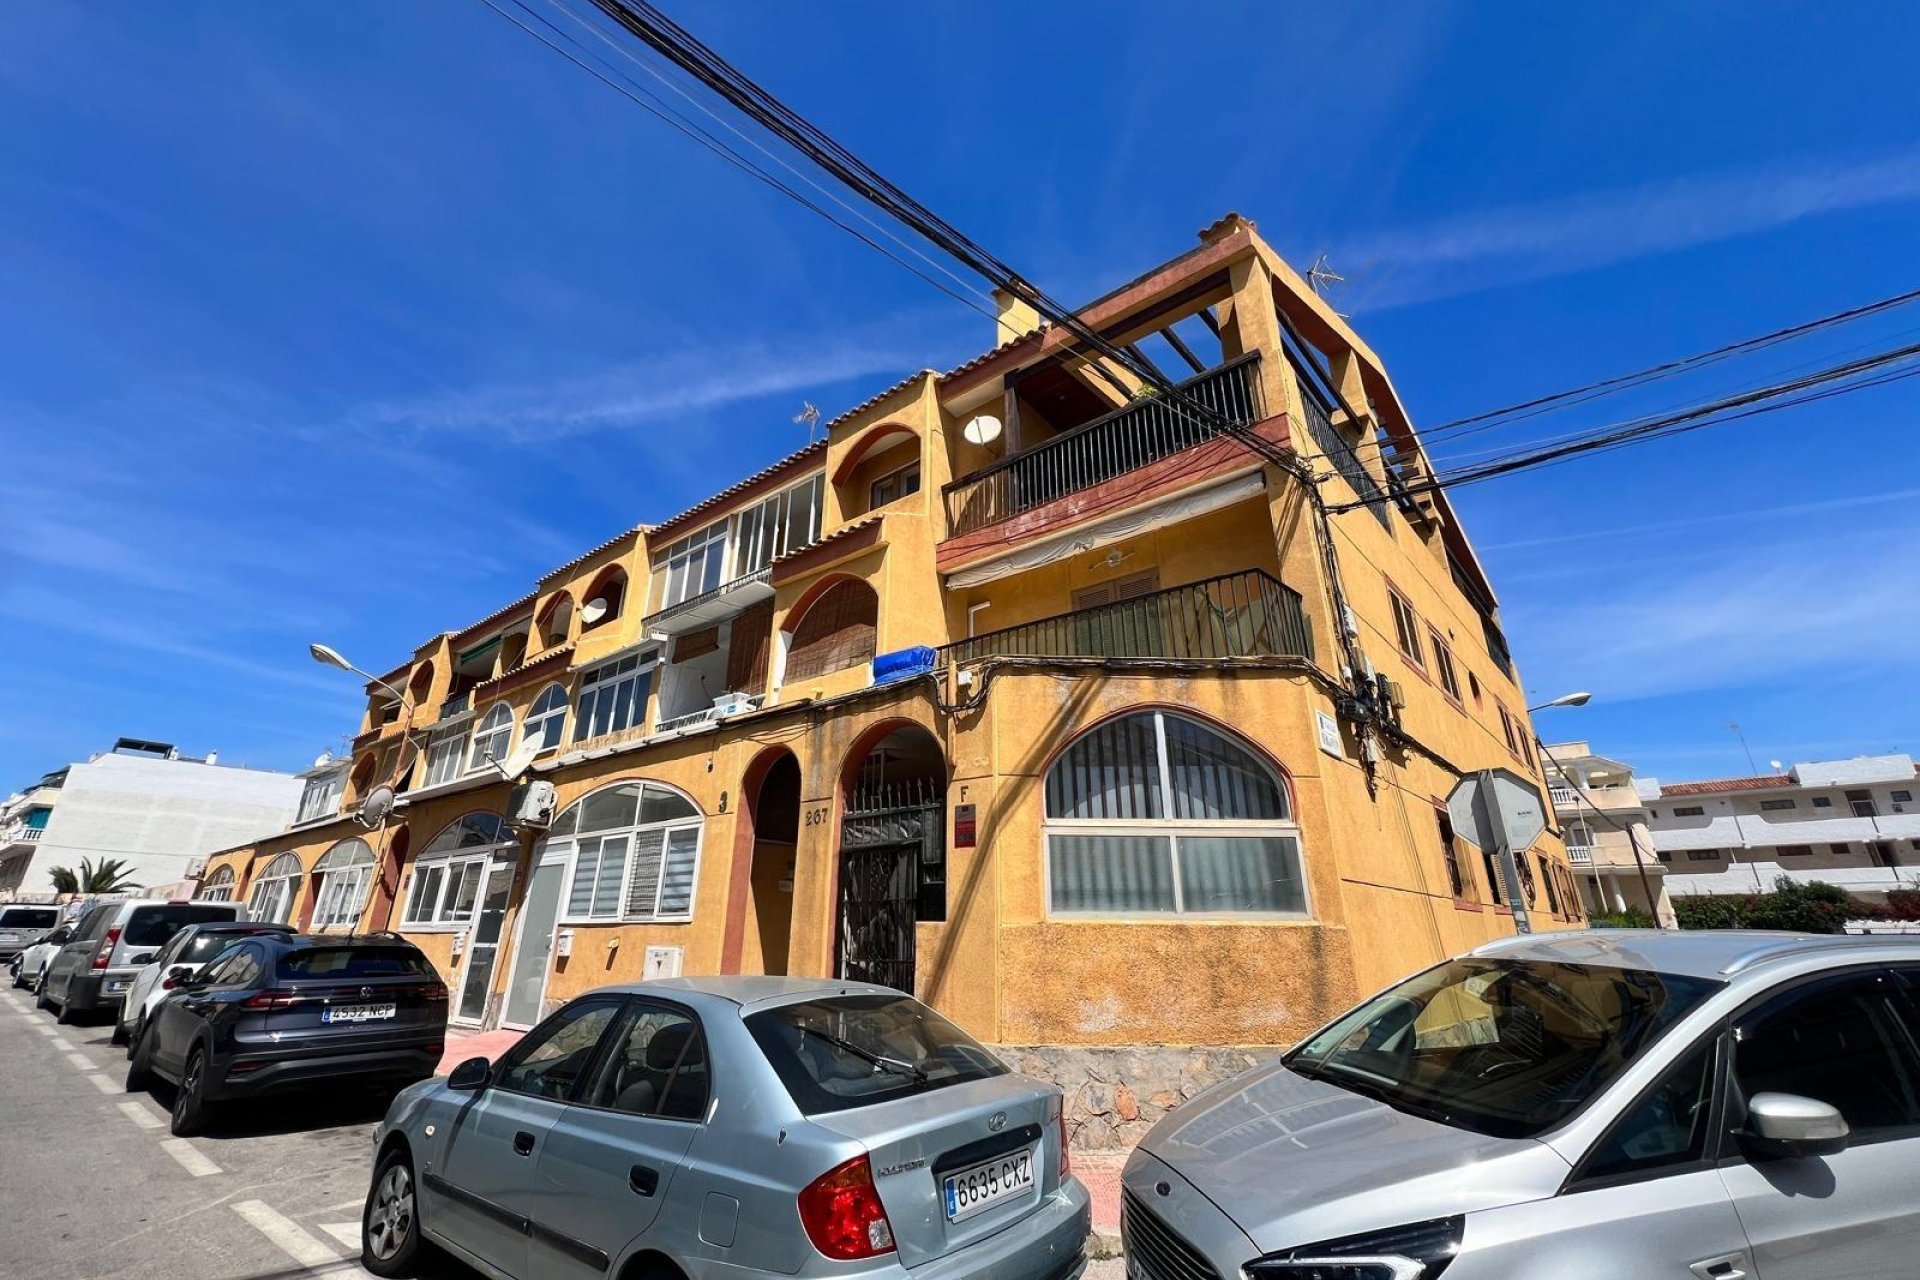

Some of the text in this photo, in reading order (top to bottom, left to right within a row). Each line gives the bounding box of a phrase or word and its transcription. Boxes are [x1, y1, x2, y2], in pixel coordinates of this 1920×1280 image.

[960, 785, 969, 803] F
[805, 807, 828, 827] 267
[333, 1006, 366, 1018] 4532
[958, 1155, 1030, 1207] 6635 CXZ
